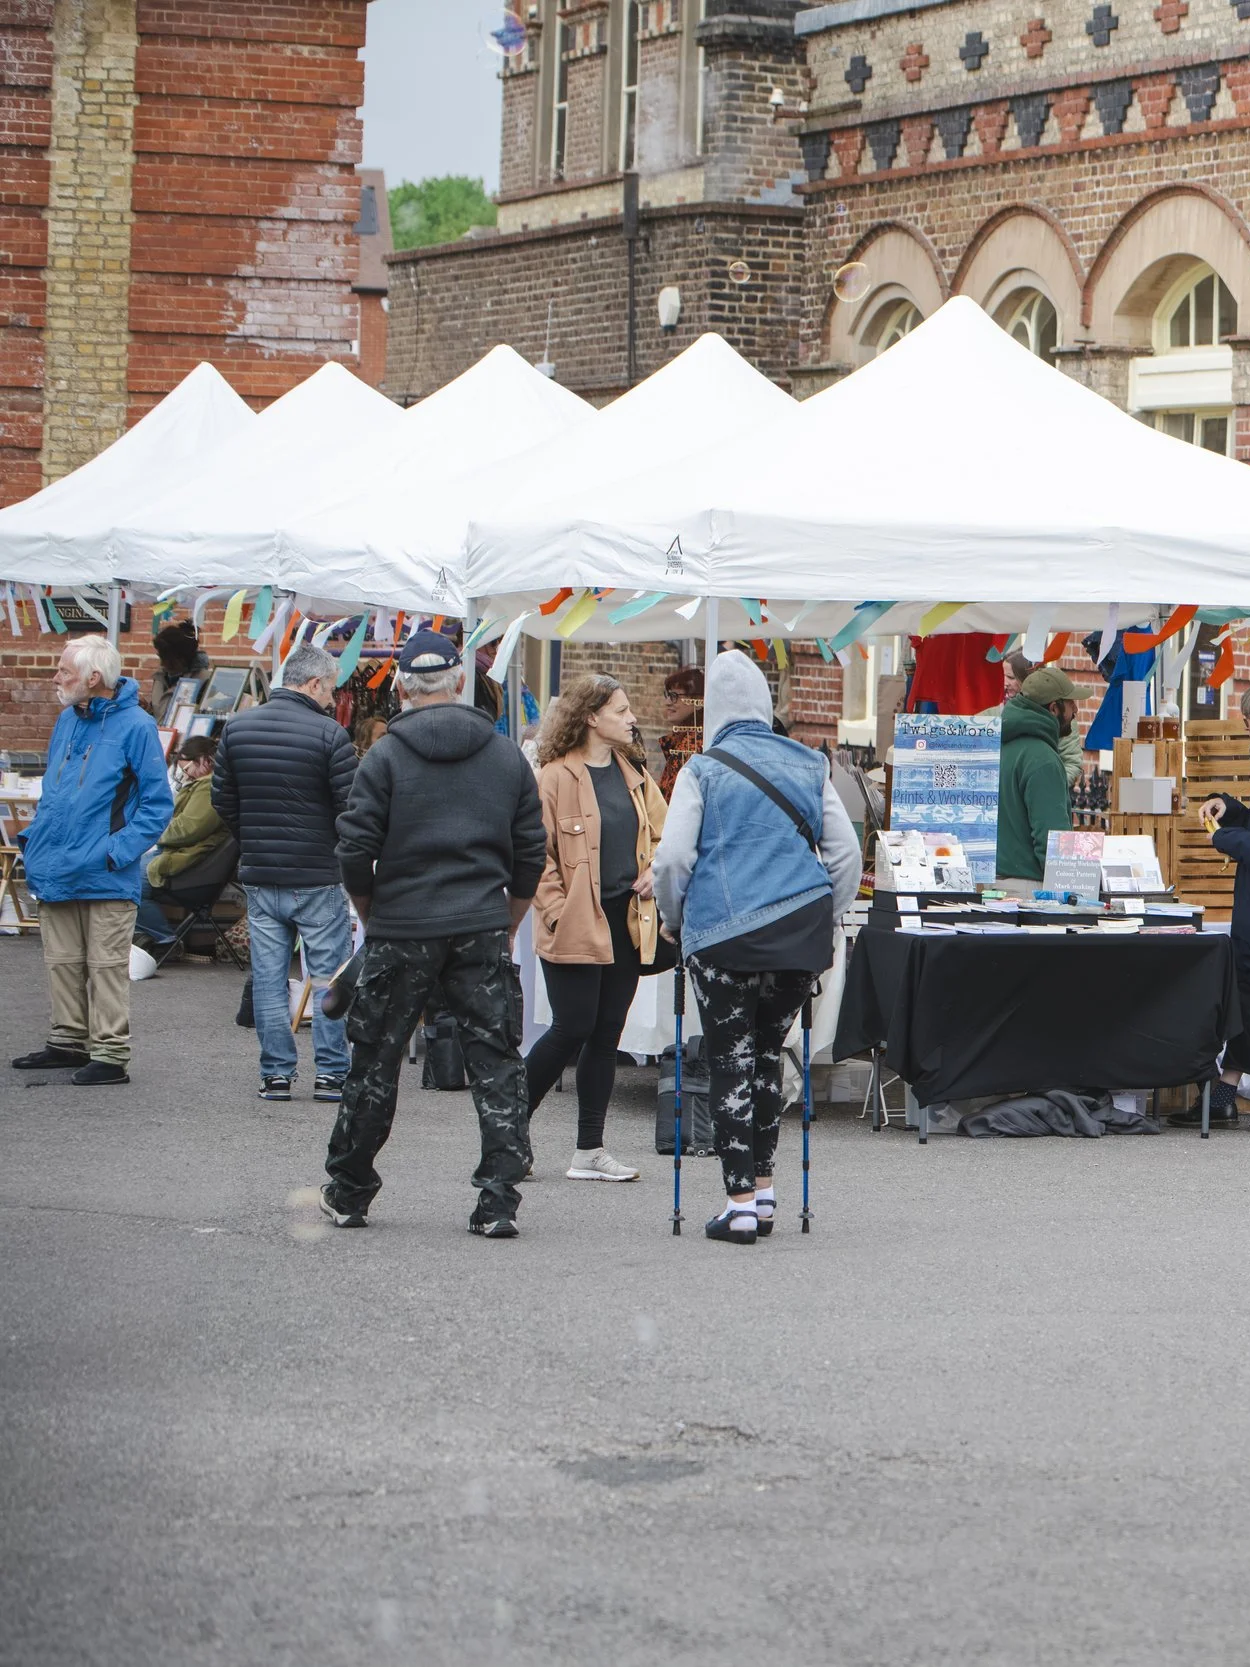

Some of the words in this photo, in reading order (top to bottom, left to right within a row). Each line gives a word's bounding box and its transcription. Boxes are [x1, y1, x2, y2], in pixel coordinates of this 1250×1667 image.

[901, 722, 994, 739] Twigs&More
[893, 790, 924, 804] Prints
[927, 790, 935, 805] &
[938, 790, 998, 809] Workshops
[1059, 860, 1077, 868] Printing
[1072, 884, 1097, 892] making
